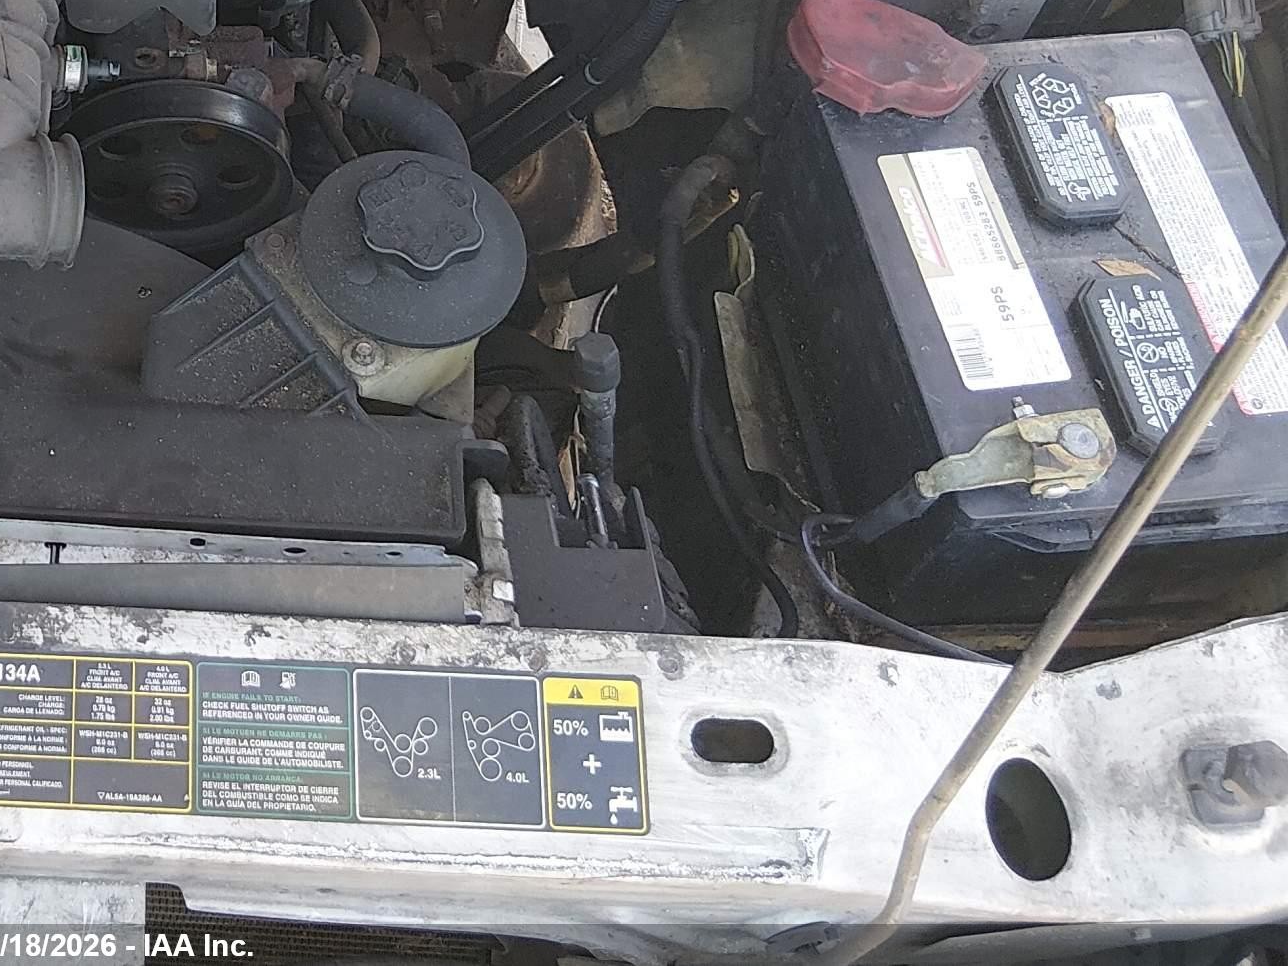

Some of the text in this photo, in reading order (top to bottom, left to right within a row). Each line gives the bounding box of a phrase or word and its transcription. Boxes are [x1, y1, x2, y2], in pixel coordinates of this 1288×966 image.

[966, 181, 983, 206] 59PS
[1133, 286, 1145, 300] ACID
[990, 285, 1015, 323] 59PS
[1099, 298, 1128, 347] POISON
[1158, 347, 1169, 358] NO
[1125, 360, 1156, 414] DANGER
[1161, 378, 1174, 396] EYES
[202, 700, 329, 714] CHECK FUEL SHUTOFF SWITCH AS
[202, 709, 342, 724] REFERENCED IN YOUR OWNER GUIDE.
[553, 719, 589, 737] 50%
[202, 735, 344, 751] VÉRIFIER LA COMMANDE DE COUPURE
[202, 744, 212, 752] DE
[265, 748, 293, 757] COMME
[202, 753, 343, 769] DANS LE GUIDE DE L'AUTOMOBILISTE.
[418, 767, 441, 780] 2.3L
[506, 771, 530, 784] 4.0L
[202, 780, 230, 789] REVISE
[242, 782, 296, 793] INTERRUPTOR
[310, 787, 338, 795] CIERRE
[202, 789, 338, 804] DEL COMBUSTIBLE COMO SE INDICA
[202, 797, 213, 806] EN
[215, 798, 225, 807] LA
[226, 799, 246, 808] GUÍA
[247, 800, 261, 809] DEL
[556, 792, 593, 810] 50%
